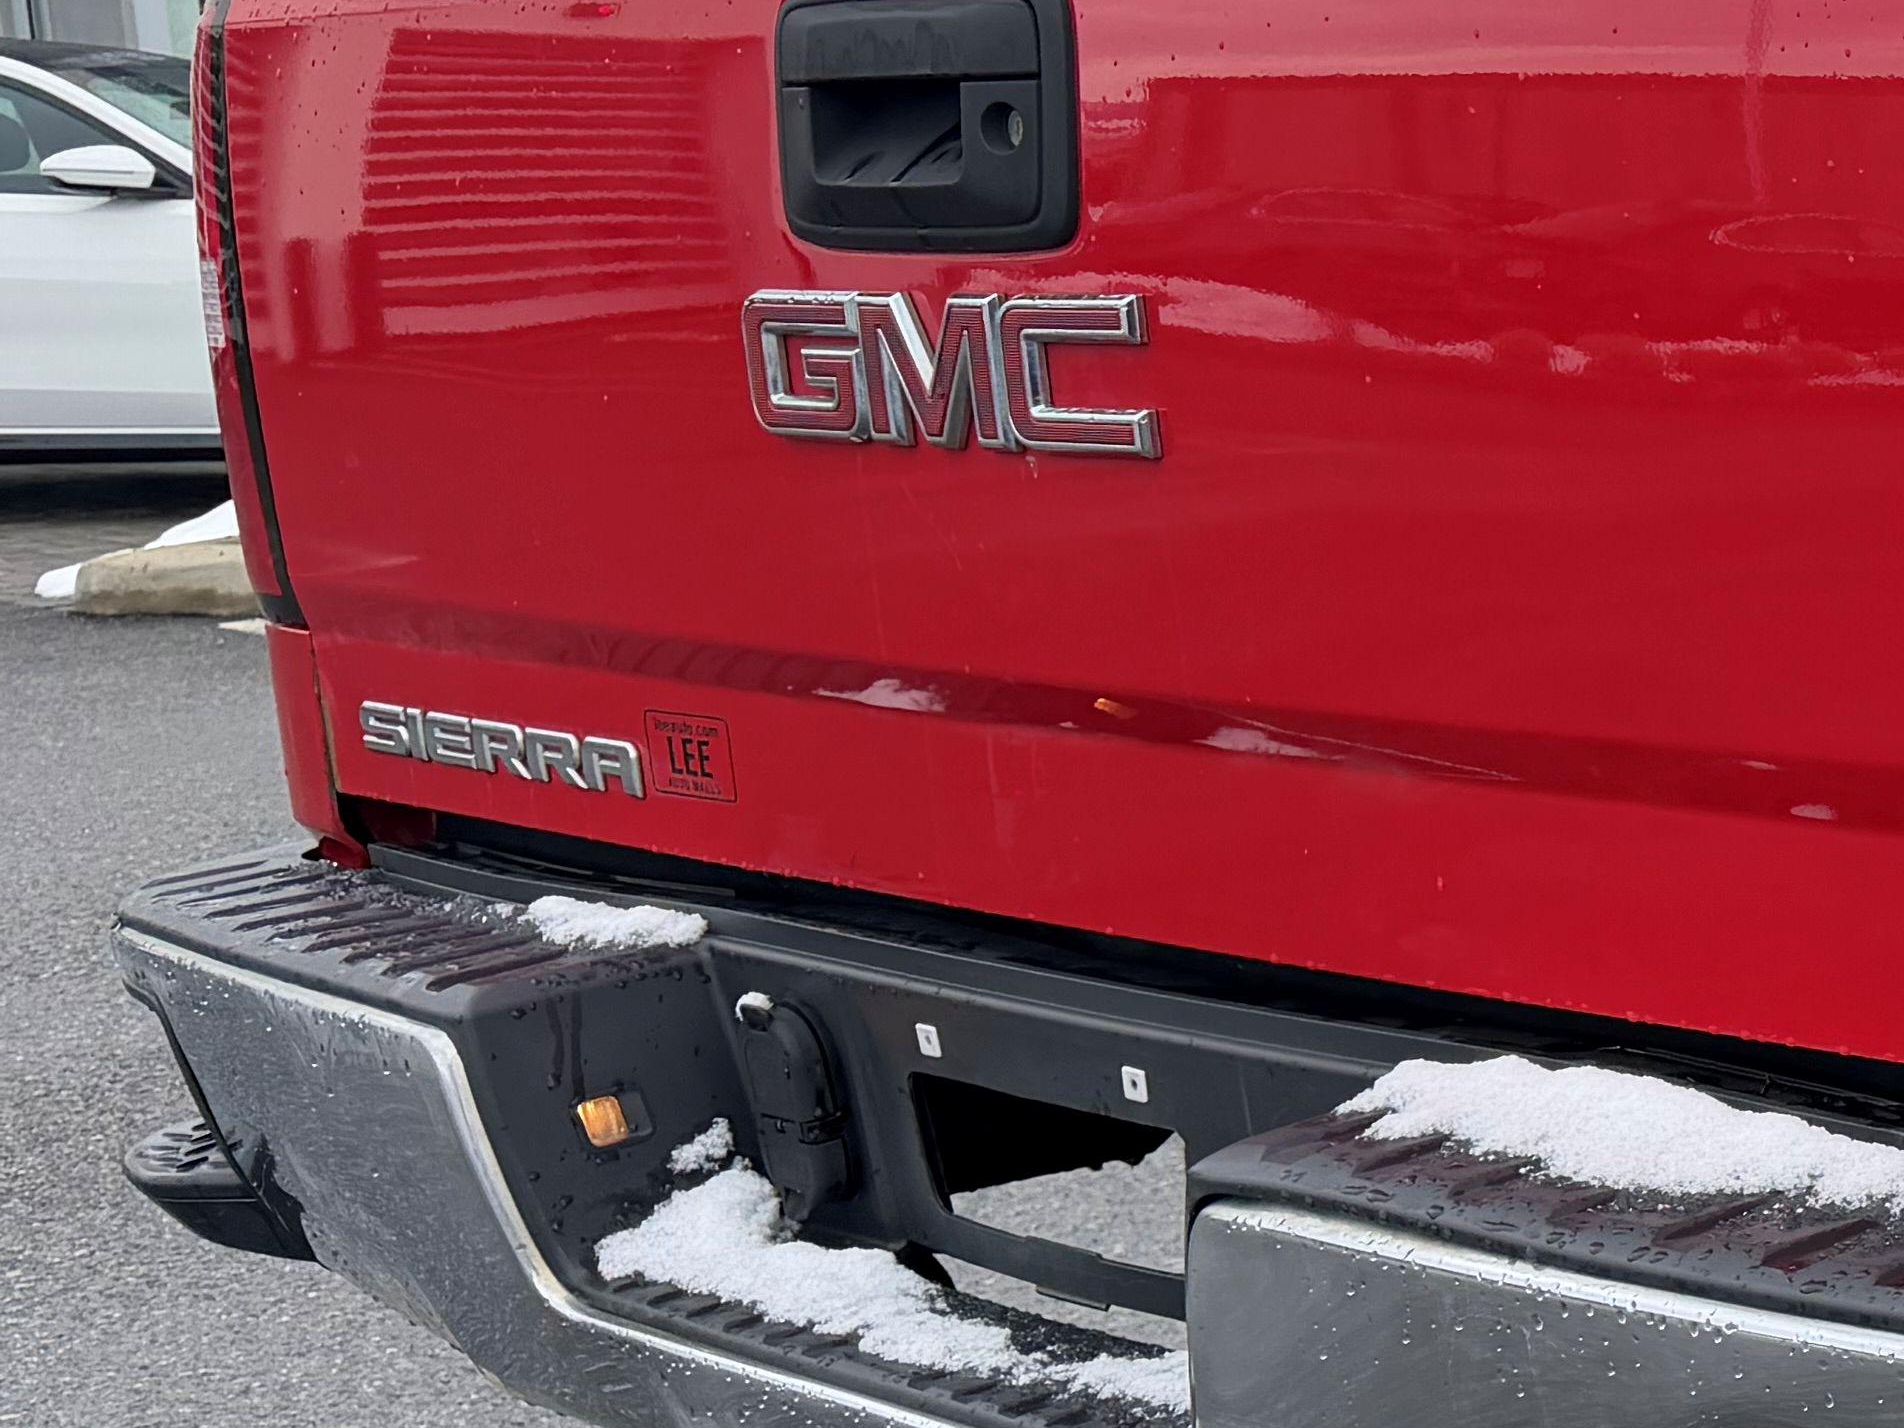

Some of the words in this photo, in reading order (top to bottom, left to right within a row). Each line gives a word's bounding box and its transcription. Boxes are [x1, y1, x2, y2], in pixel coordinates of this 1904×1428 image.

[741, 288, 1163, 460] GMC
[359, 699, 646, 801] SIERRA
[666, 735, 714, 780] LEE
